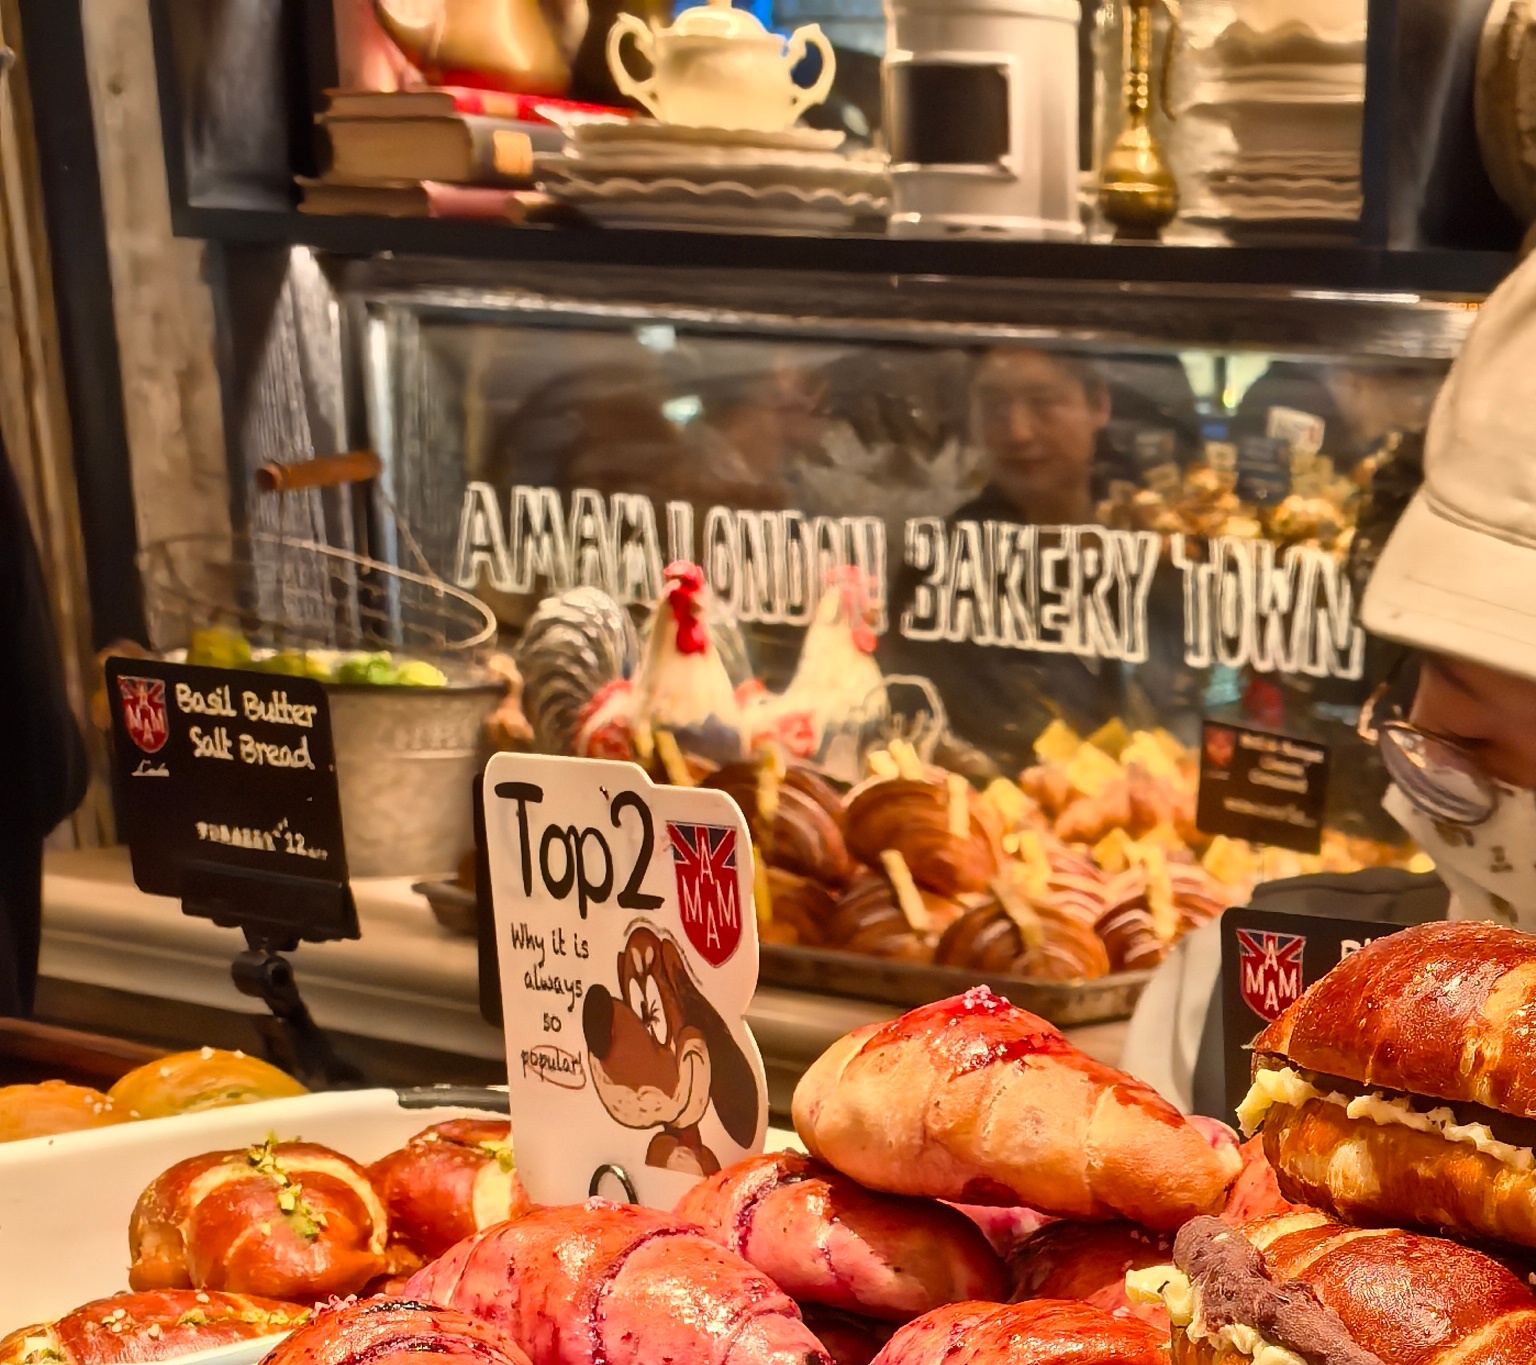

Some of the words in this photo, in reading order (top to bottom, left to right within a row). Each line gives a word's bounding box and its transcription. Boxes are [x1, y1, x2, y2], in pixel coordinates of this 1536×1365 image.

[901, 516, 1161, 664] BAKERY
[1171, 531, 1366, 681] TOWN
[174, 682, 237, 718] Basil
[242, 689, 318, 728] Butter
[189, 725, 234, 762] Salt
[238, 733, 316, 771] Bread
[494, 781, 666, 919] Top2
[511, 922, 547, 967] Why
[551, 928, 568, 958] it
[573, 932, 590, 960] is
[524, 964, 584, 1013] always
[542, 1012, 562, 1034] so
